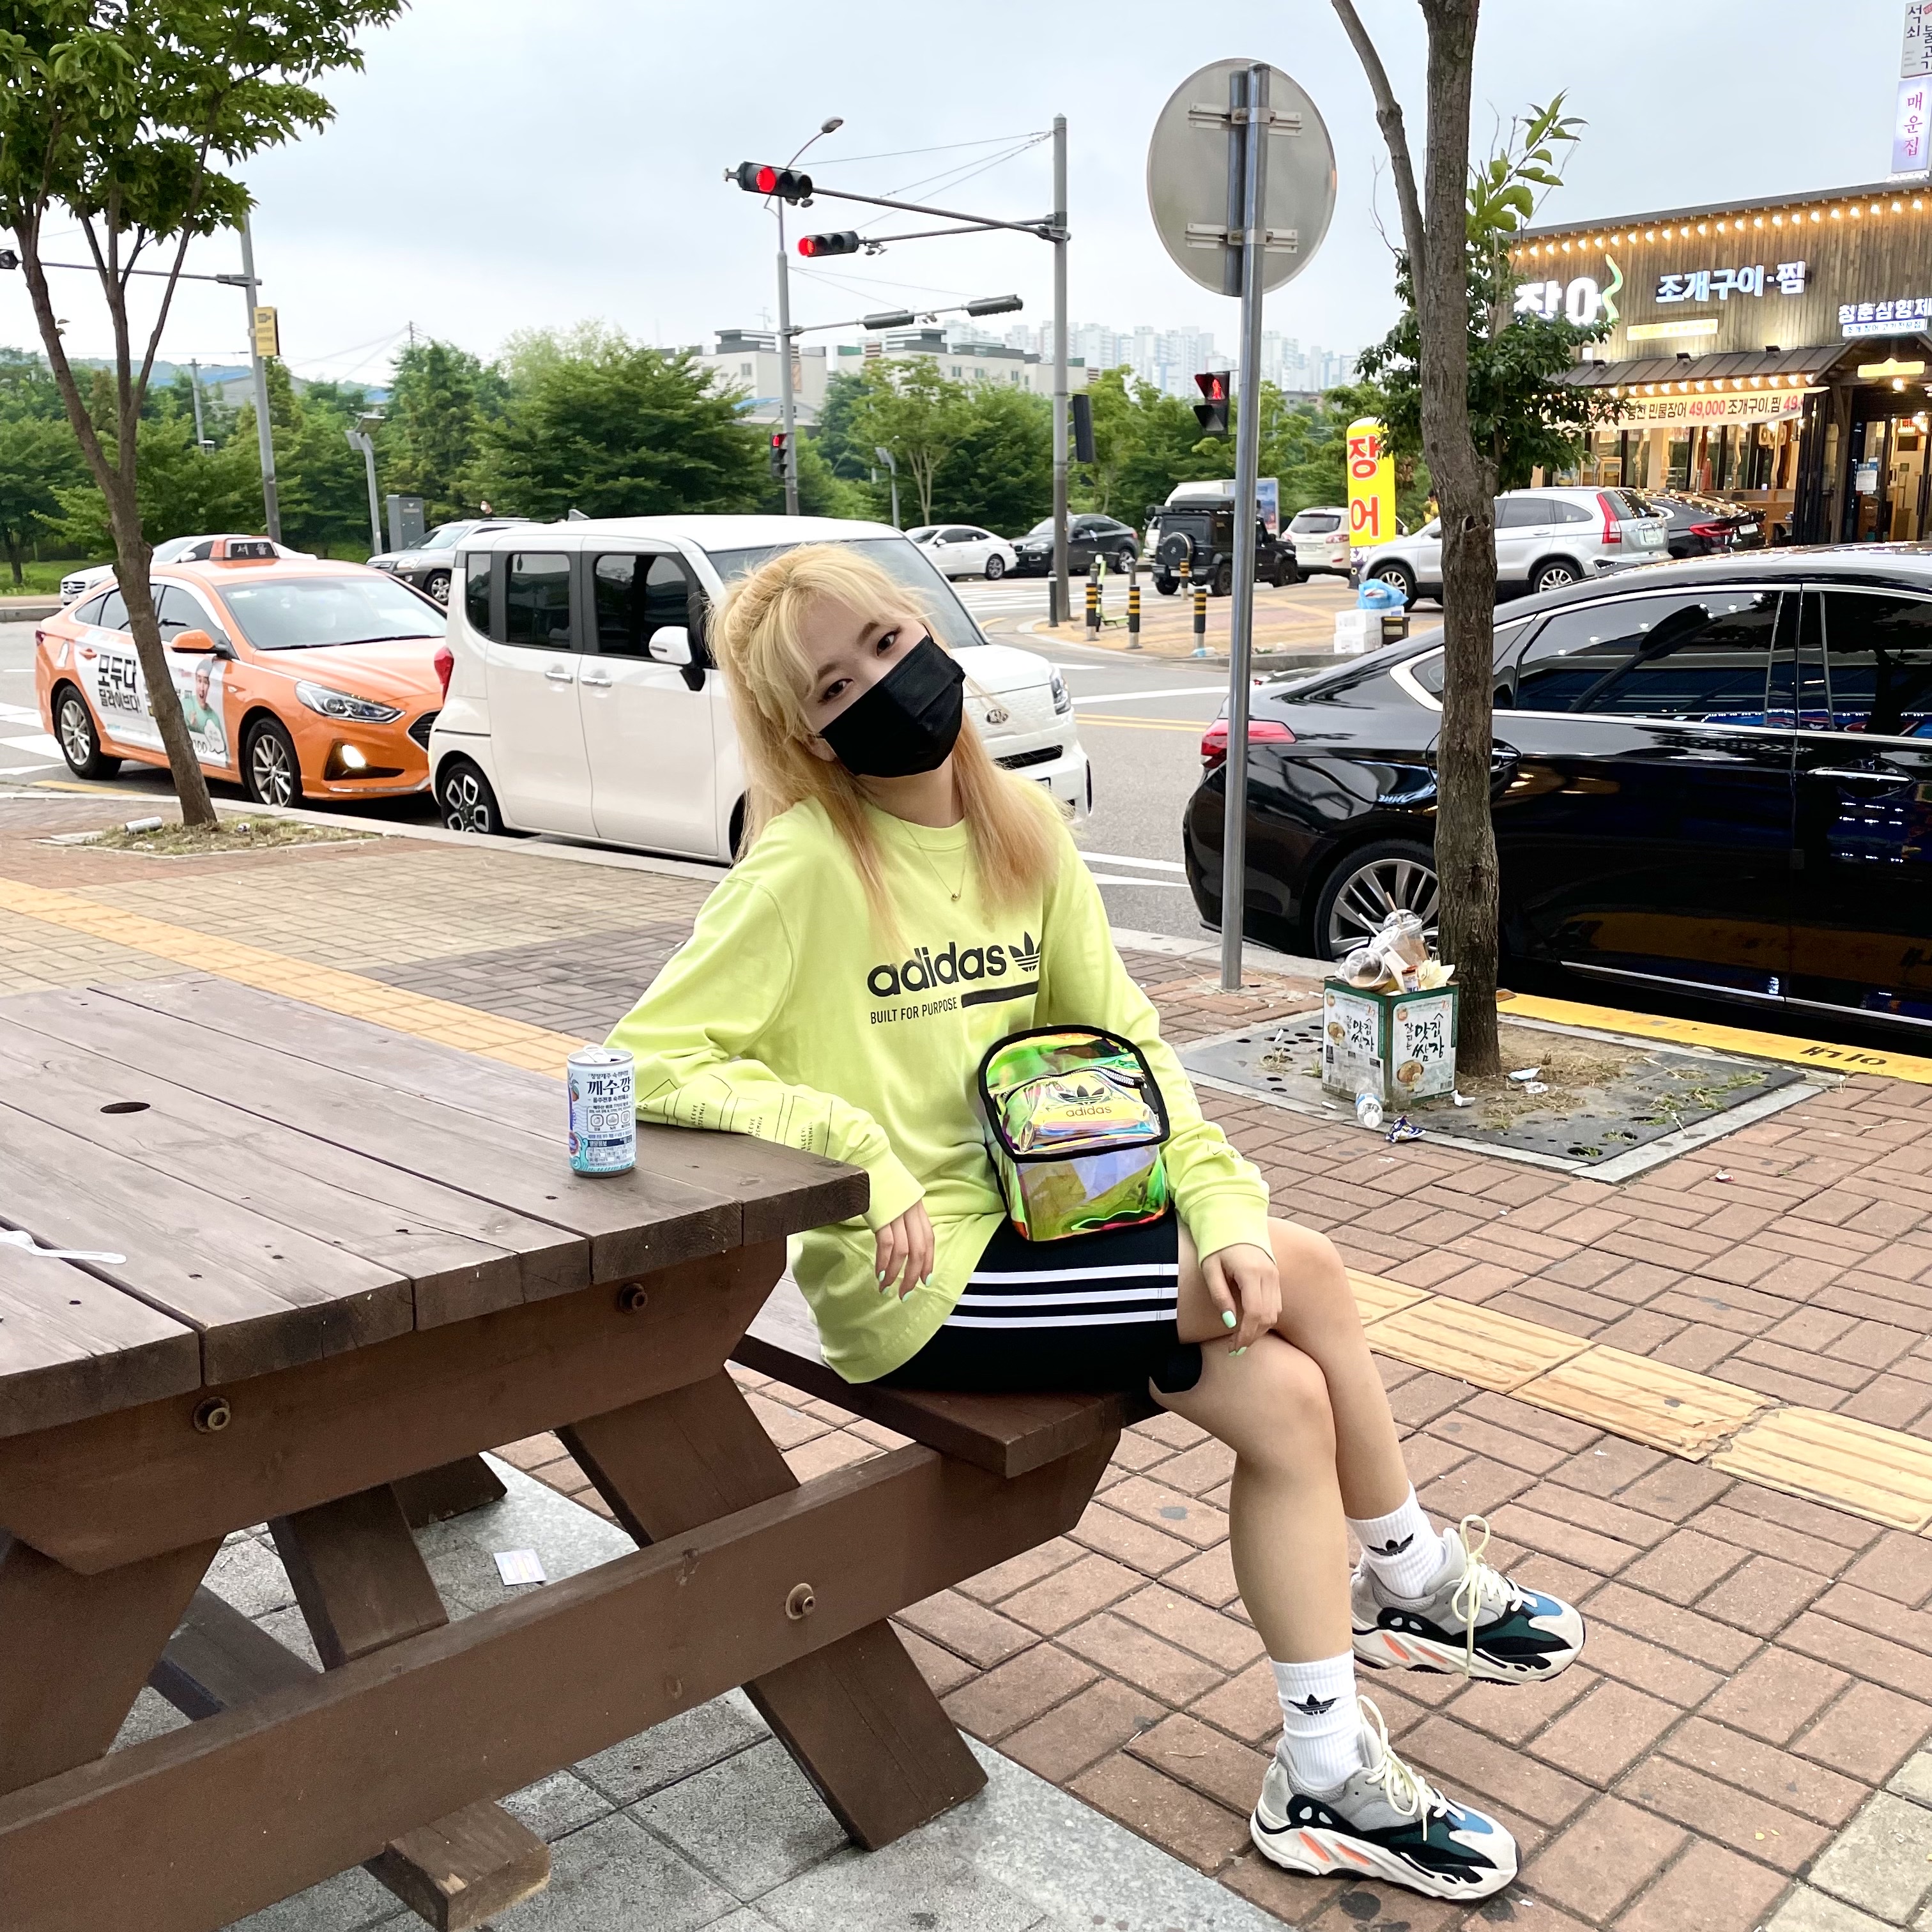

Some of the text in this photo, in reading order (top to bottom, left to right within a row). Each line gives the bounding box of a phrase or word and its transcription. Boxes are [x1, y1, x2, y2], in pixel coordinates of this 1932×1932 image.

[1906, 4, 1922, 38] 석쇠
[1839, 298, 1932, 325] 청춘삼형제
[1649, 402, 1687, 419] 민물장어
[1689, 400, 1726, 419] 49,000
[1349, 436, 1381, 537] 장어
[868, 941, 1007, 997] adidas
[870, 997, 958, 1024] BUILT FOR PURPOSE
[1353, 1020, 1372, 1036] 맛집
[1414, 1021, 1441, 1043] 맛집
[1351, 1033, 1375, 1052] 쌈장
[1412, 1036, 1445, 1062] 쌈장
[586, 1076, 632, 1096] 깨수깡
[1066, 1105, 1112, 1117] adidas
